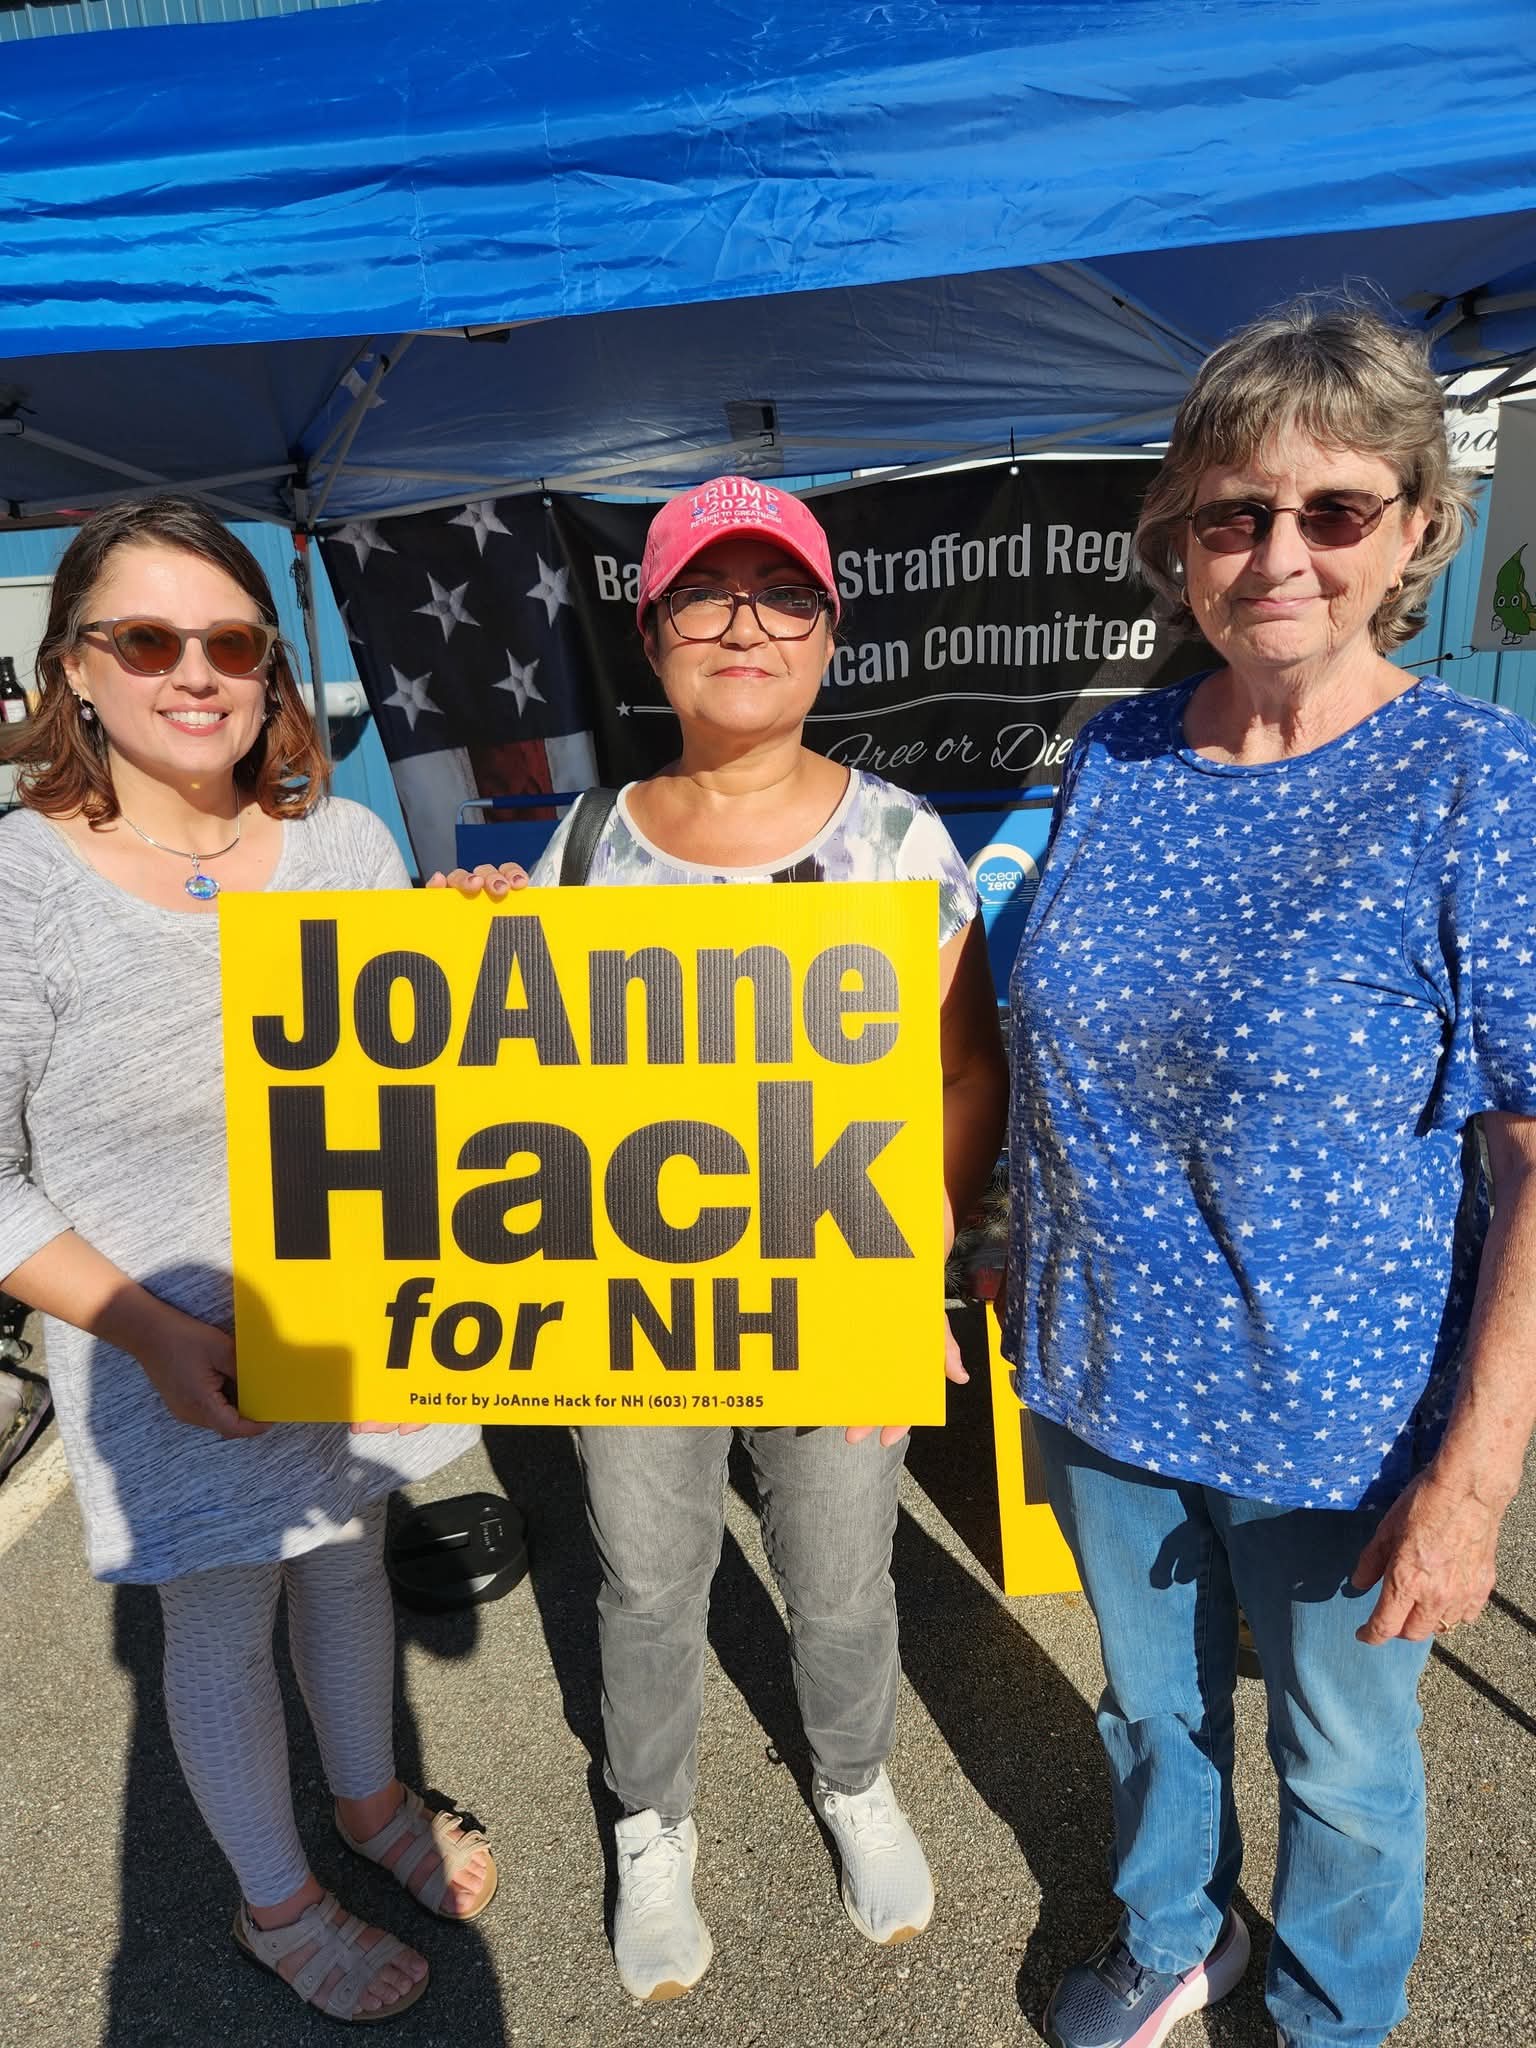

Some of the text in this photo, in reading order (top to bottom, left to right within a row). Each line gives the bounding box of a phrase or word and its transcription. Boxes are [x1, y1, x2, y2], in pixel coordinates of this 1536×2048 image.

[690, 483, 779, 508] TRUMP
[708, 498, 761, 514] 2024
[838, 523, 1031, 600] Strafford
[1046, 524, 1141, 582] Reg
[825, 723, 1074, 772] Free or Die
[979, 871, 1022, 882] ocean
[987, 881, 1016, 891] zero
[252, 915, 900, 1071] JoAnne
[268, 1080, 916, 1265] Hack
[385, 1277, 799, 1371] for NH
[409, 1392, 764, 1409] Paid for by JoAnne Hack for NH (603) 781-0385
